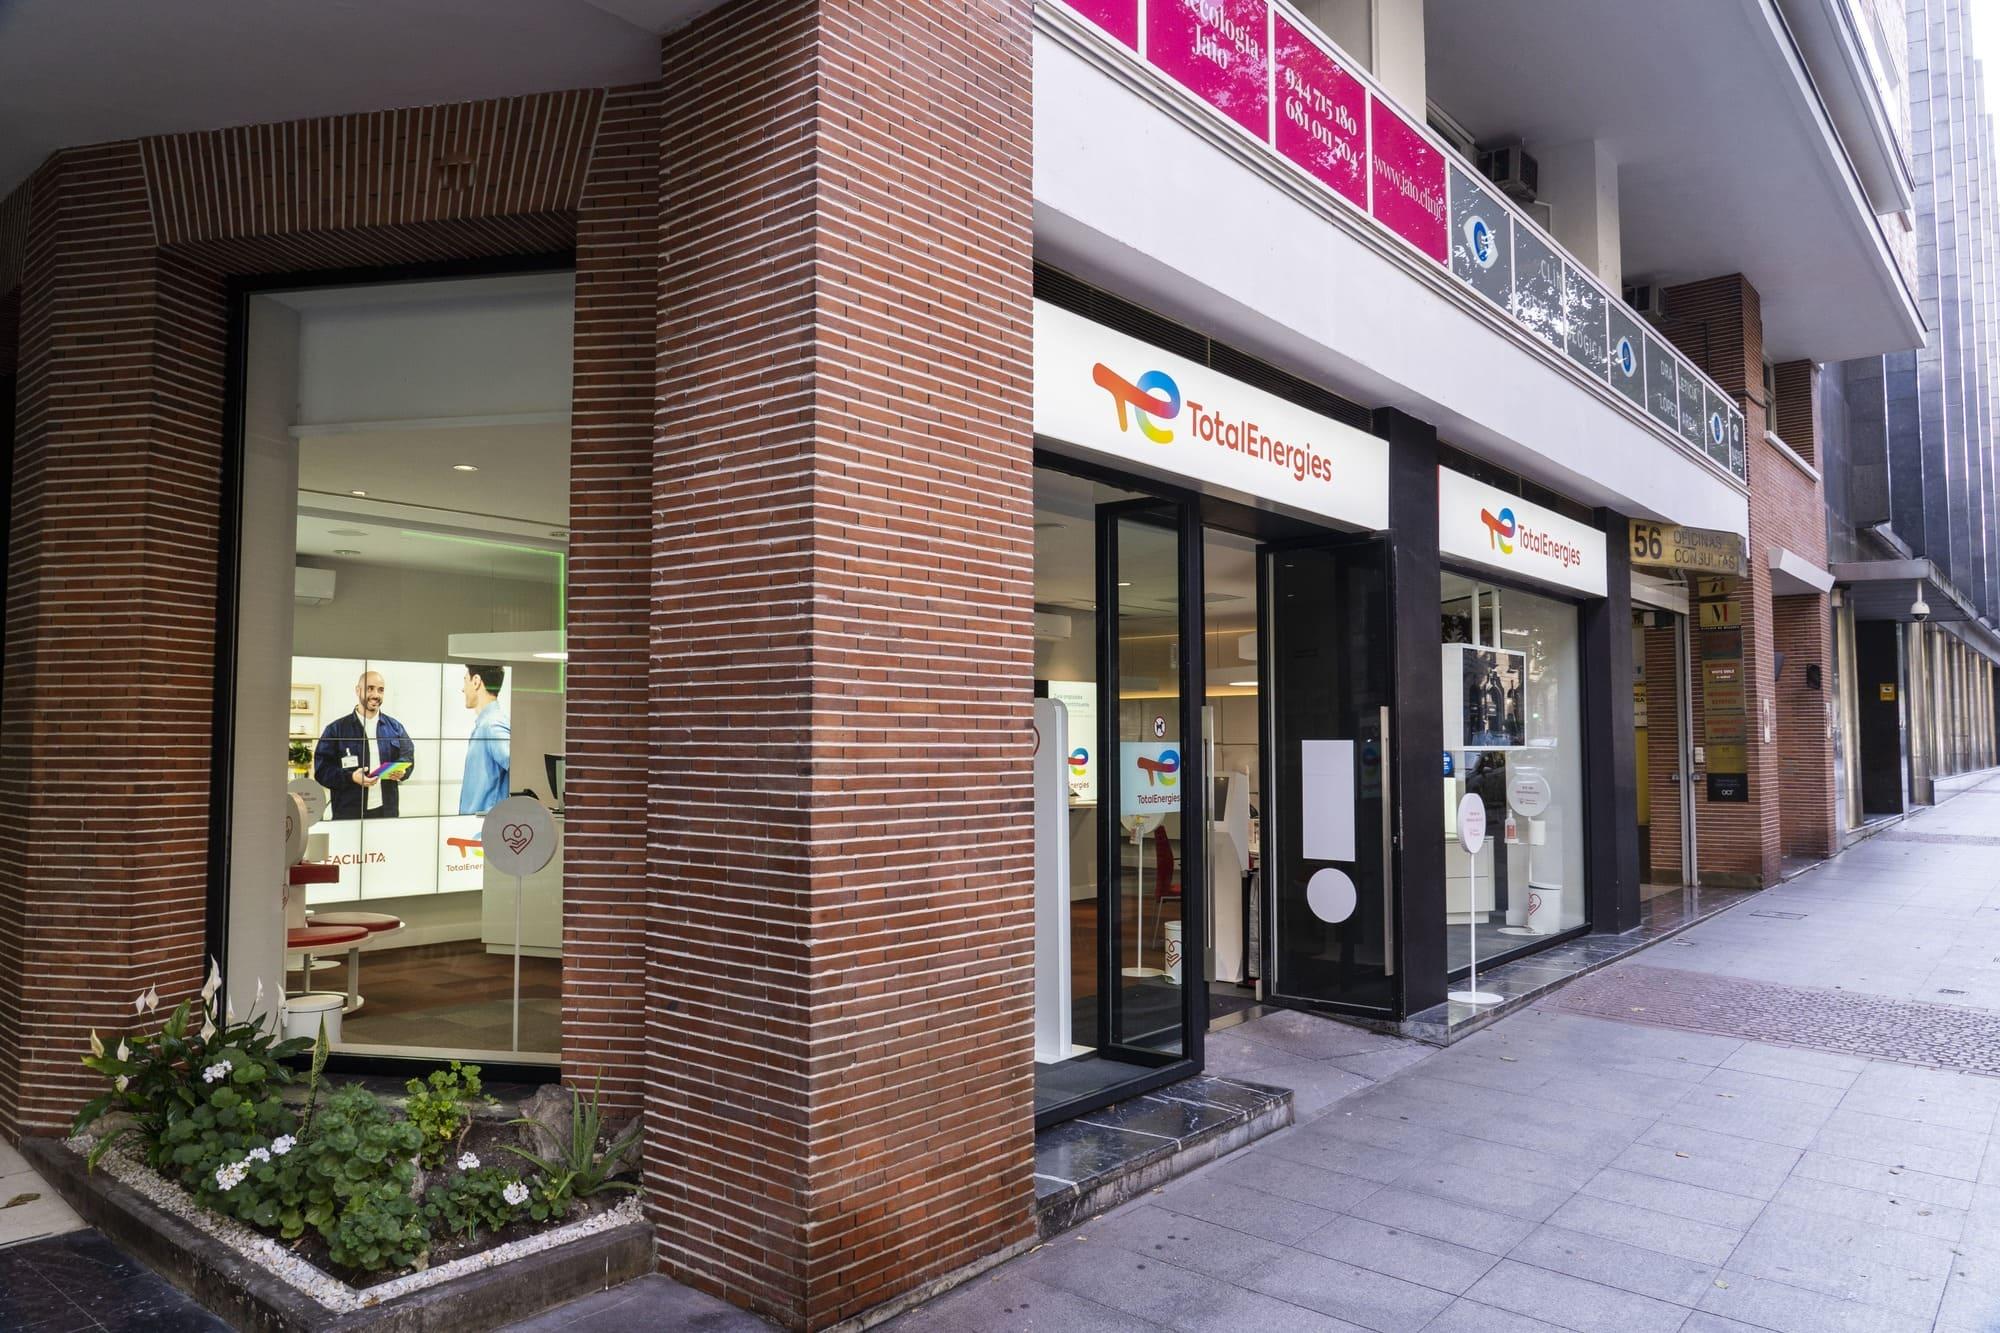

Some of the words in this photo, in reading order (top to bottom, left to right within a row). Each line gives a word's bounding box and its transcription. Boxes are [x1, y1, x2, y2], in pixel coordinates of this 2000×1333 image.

[1191, 24, 1228, 70] Jaio
[1285, 67, 1311, 106] 944
[1313, 87, 1333, 120] 715
[1334, 104, 1357, 136] 180
[1285, 96, 1309, 132] 681
[1186, 400, 1332, 481] TotalEnergies
[1518, 524, 1581, 568] TotalEnergies
[1633, 523, 1663, 560] 56
[1673, 529, 1722, 550] OFICINAS
[1674, 548, 1736, 570] CONSULTAS
[446, 863, 483, 872] TotalEner
